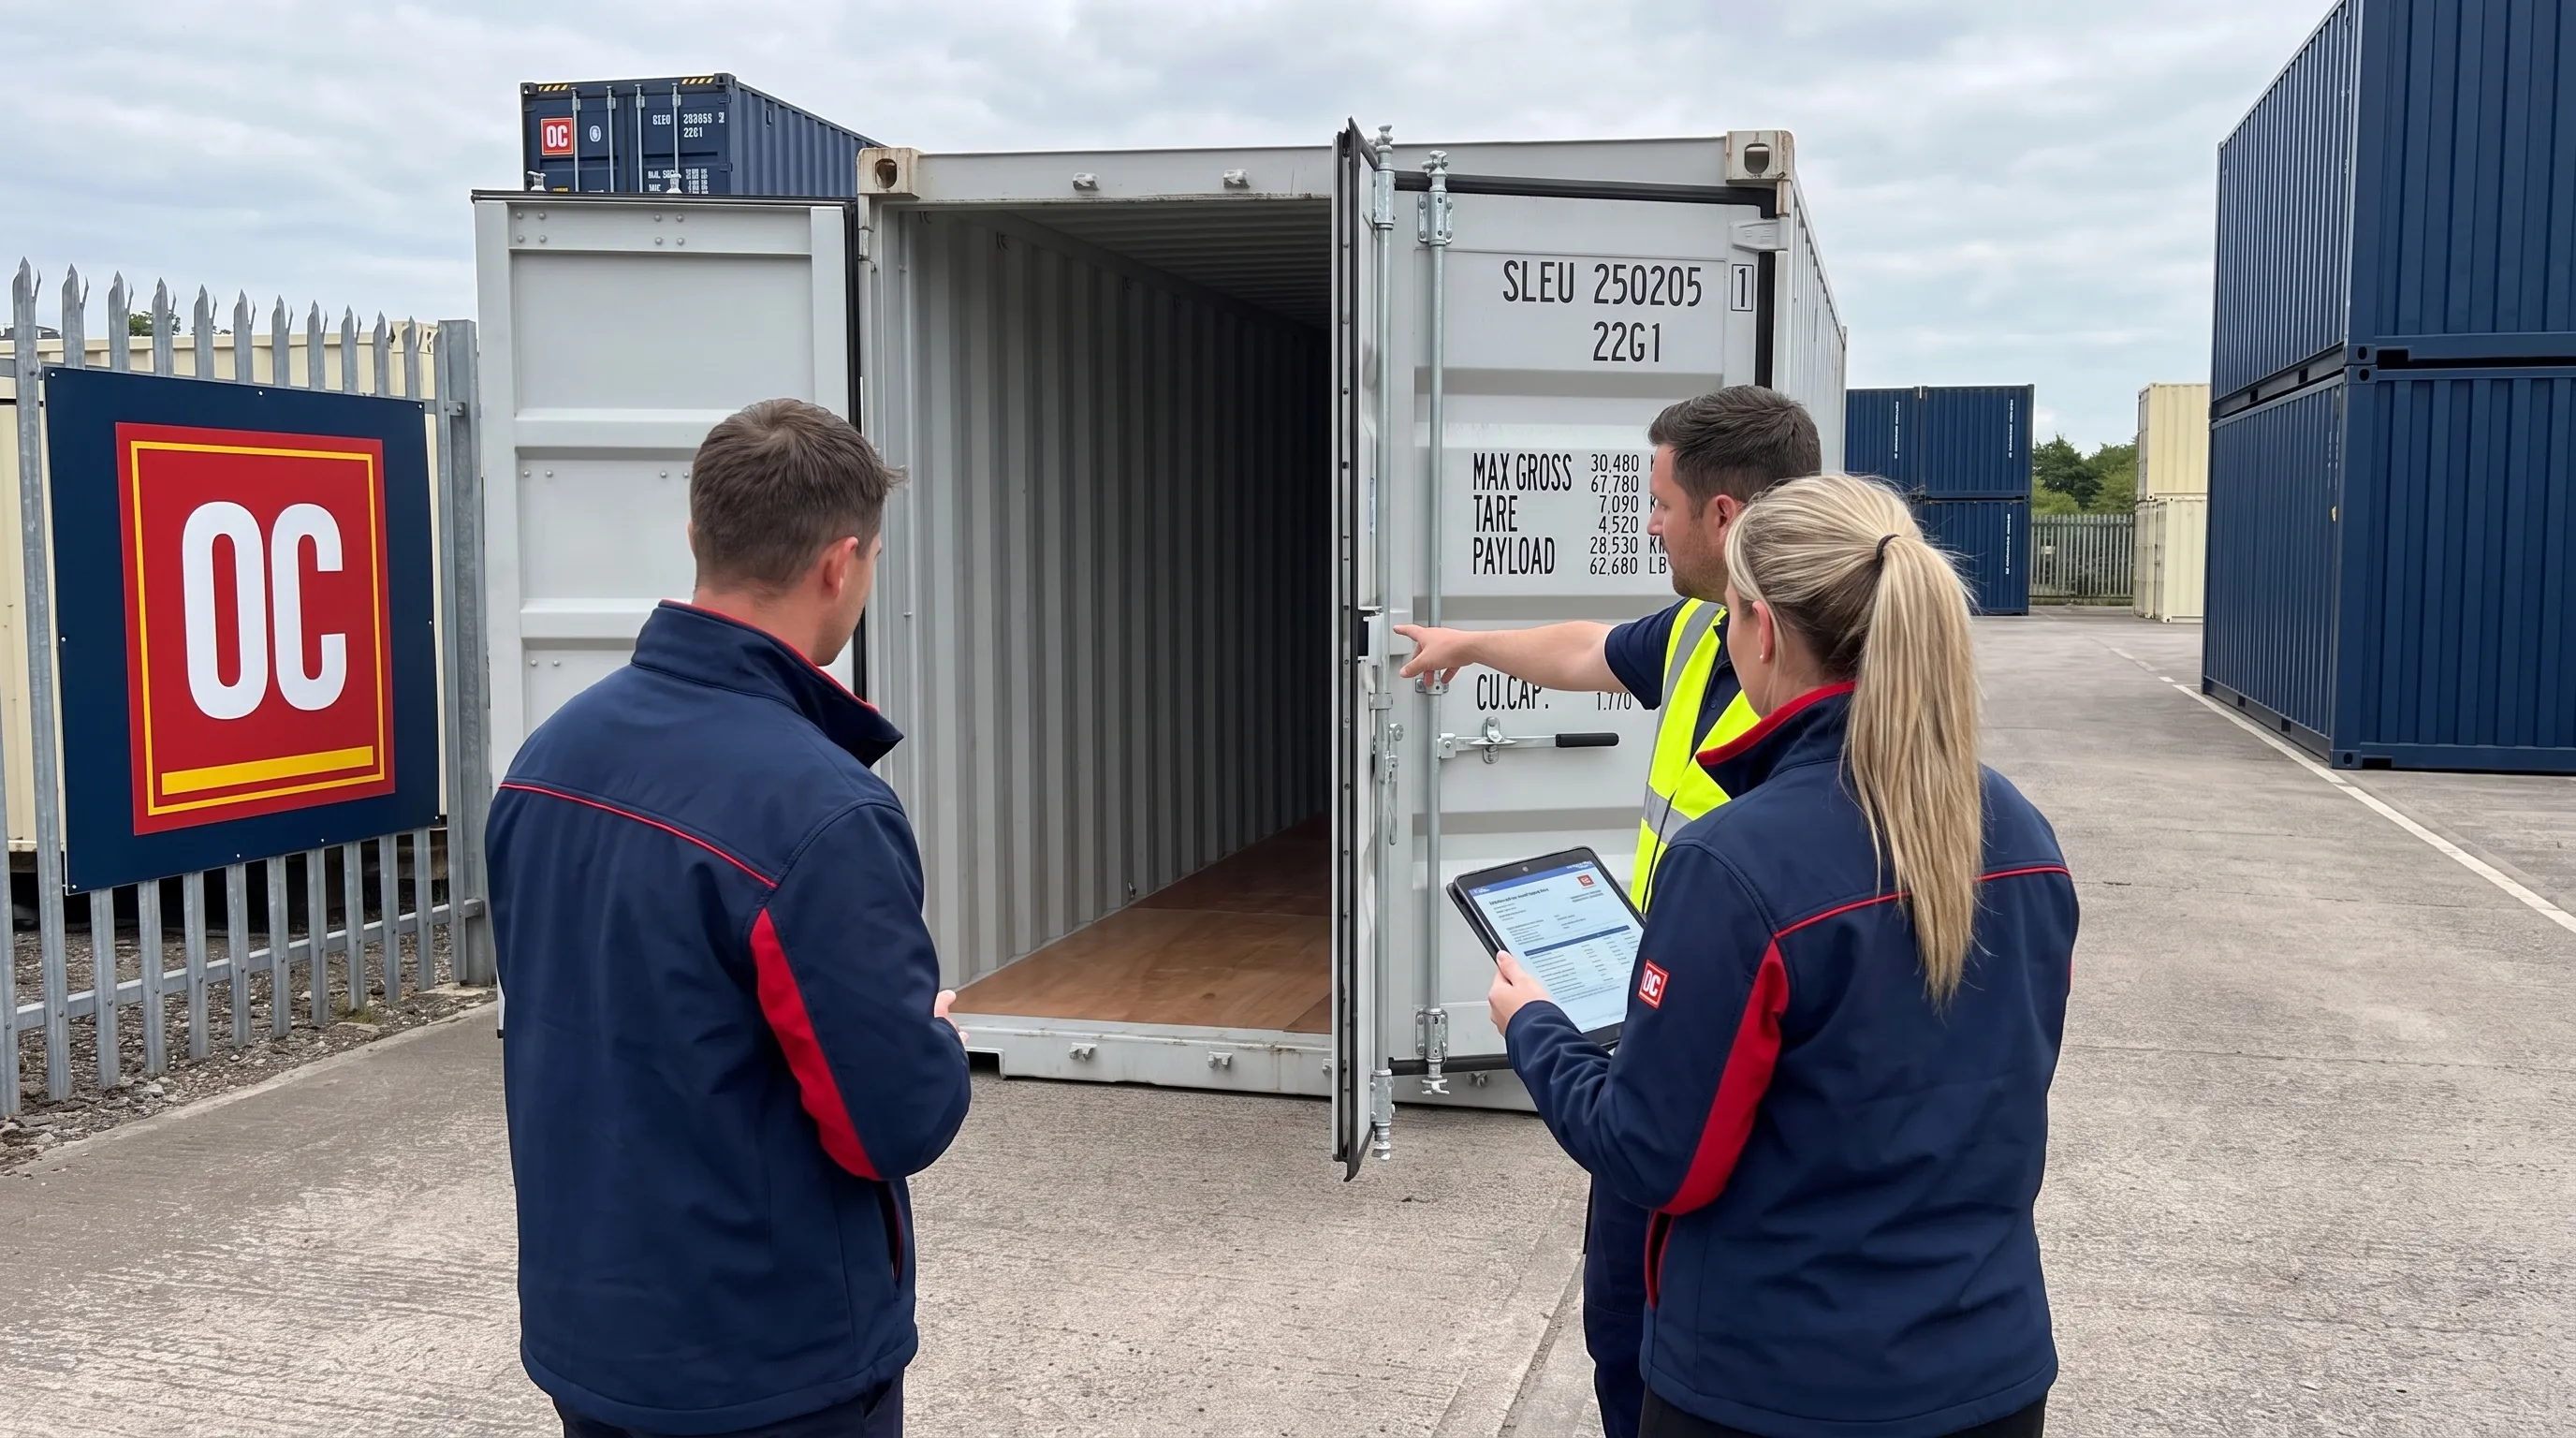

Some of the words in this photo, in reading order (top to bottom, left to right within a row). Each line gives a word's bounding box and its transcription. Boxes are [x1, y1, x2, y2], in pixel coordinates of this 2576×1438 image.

[546, 125, 568, 148] OC
[1502, 259, 1574, 304] SLEU
[1593, 263, 1702, 307] 250205
[1738, 267, 1747, 308] 1
[1592, 321, 1661, 362] 22G1
[1473, 453, 1510, 491] MAX
[1515, 453, 1573, 492] GROSS
[1590, 453, 1640, 475] 30,480
[1590, 475, 1639, 494] 67,780
[1473, 494, 1518, 533] TARE
[1599, 495, 1639, 515] 7,090
[1598, 516, 1639, 536] 4,520
[1472, 536, 1556, 575] PAYLOAD
[1589, 536, 1639, 556] 28,530
[1589, 557, 1638, 577] 62,680
[1649, 556, 1667, 575] LB
[182, 501, 347, 720] OC
[1643, 969, 1661, 997] OC
